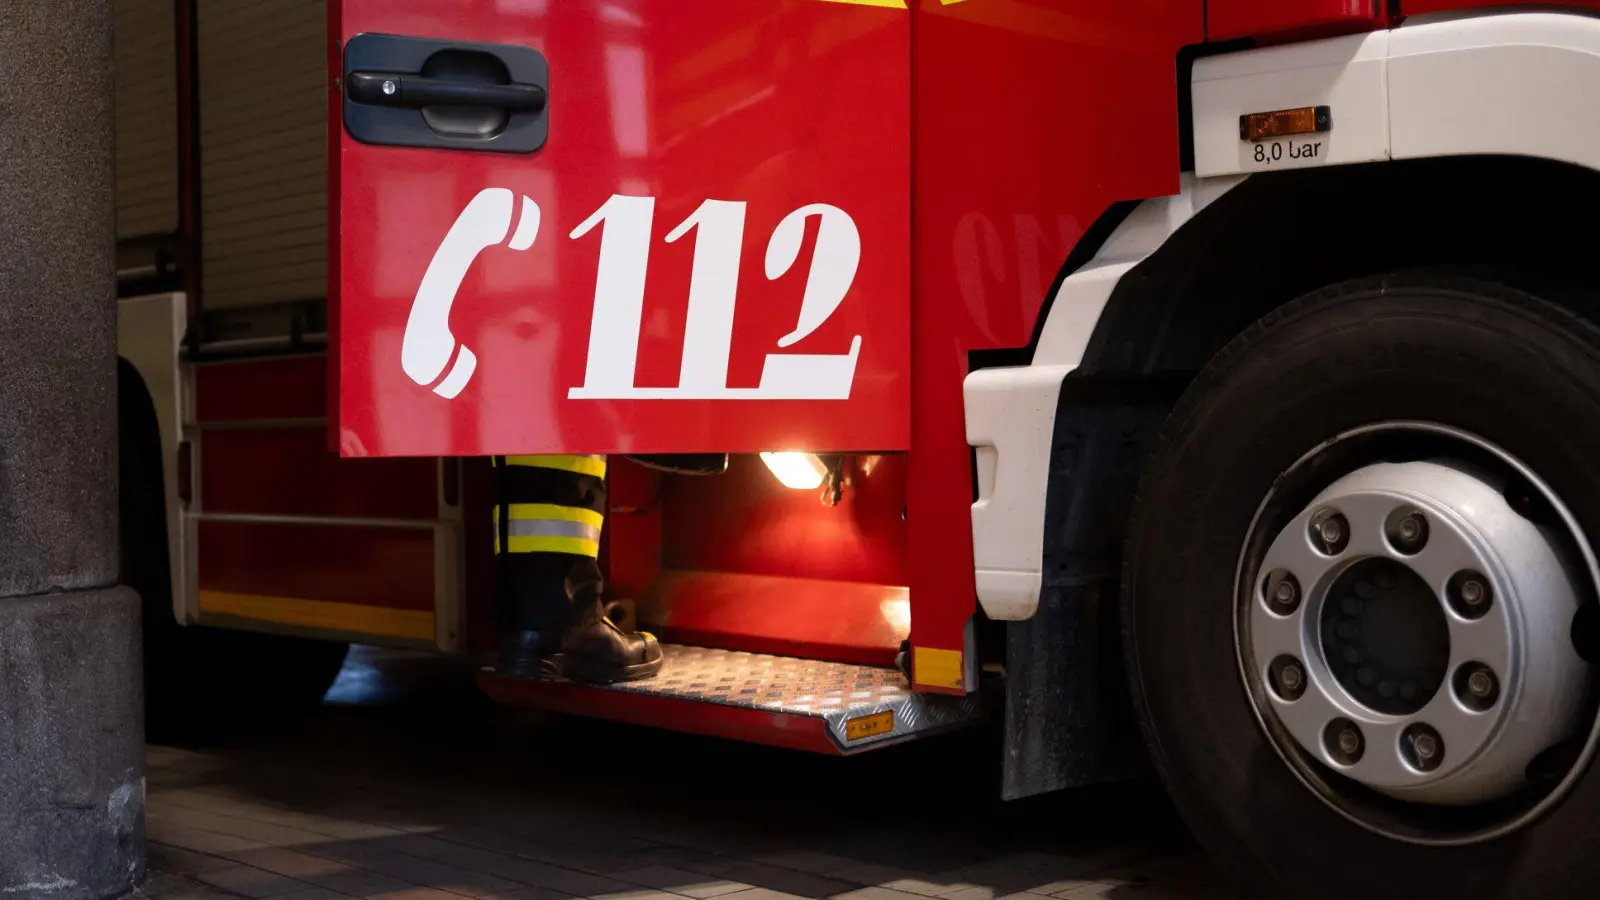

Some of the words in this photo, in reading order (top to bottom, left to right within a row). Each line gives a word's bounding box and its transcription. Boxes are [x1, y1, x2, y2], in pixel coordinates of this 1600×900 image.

[1254, 142, 1282, 164] 8,0
[1289, 141, 1322, 159] bar
[567, 193, 862, 400] 112
